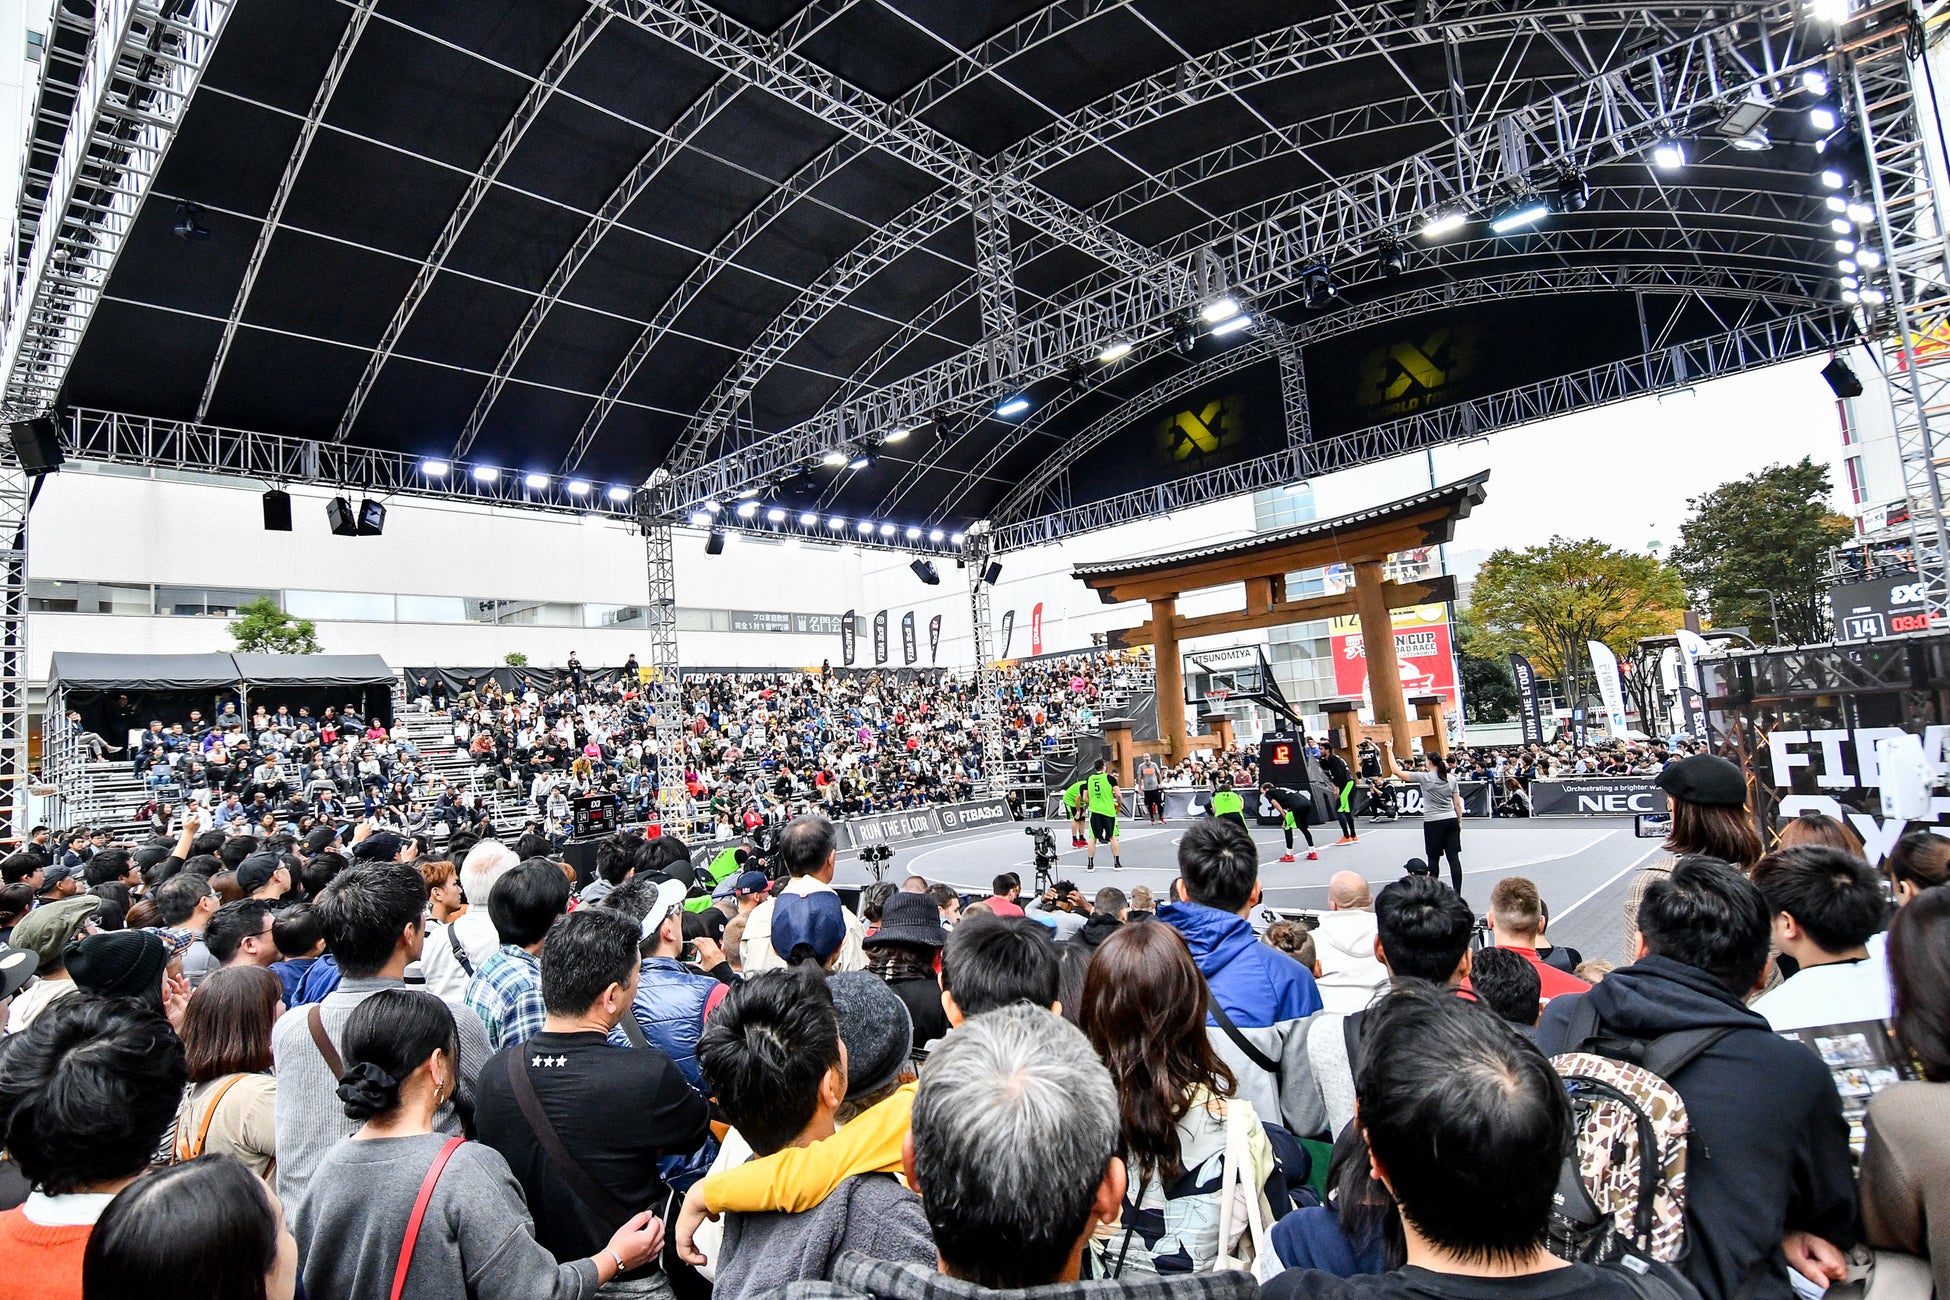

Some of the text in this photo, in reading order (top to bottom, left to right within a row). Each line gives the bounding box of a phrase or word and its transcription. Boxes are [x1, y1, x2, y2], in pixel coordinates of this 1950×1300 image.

[809, 616, 842, 633] 名門会
[1852, 618, 1877, 638] 14
[1408, 632, 1434, 645] CUP
[1396, 643, 1436, 653] OAD RACE
[1192, 649, 1252, 663] UTSUNOMIYA
[1277, 746, 1289, 760] 12
[1094, 781, 1101, 792] 5
[1619, 784, 1648, 793] brighter
[1578, 793, 1654, 812] NEC
[959, 804, 1004, 823] FIBA3x3
[860, 815, 930, 841] RUN THE FLOOR
